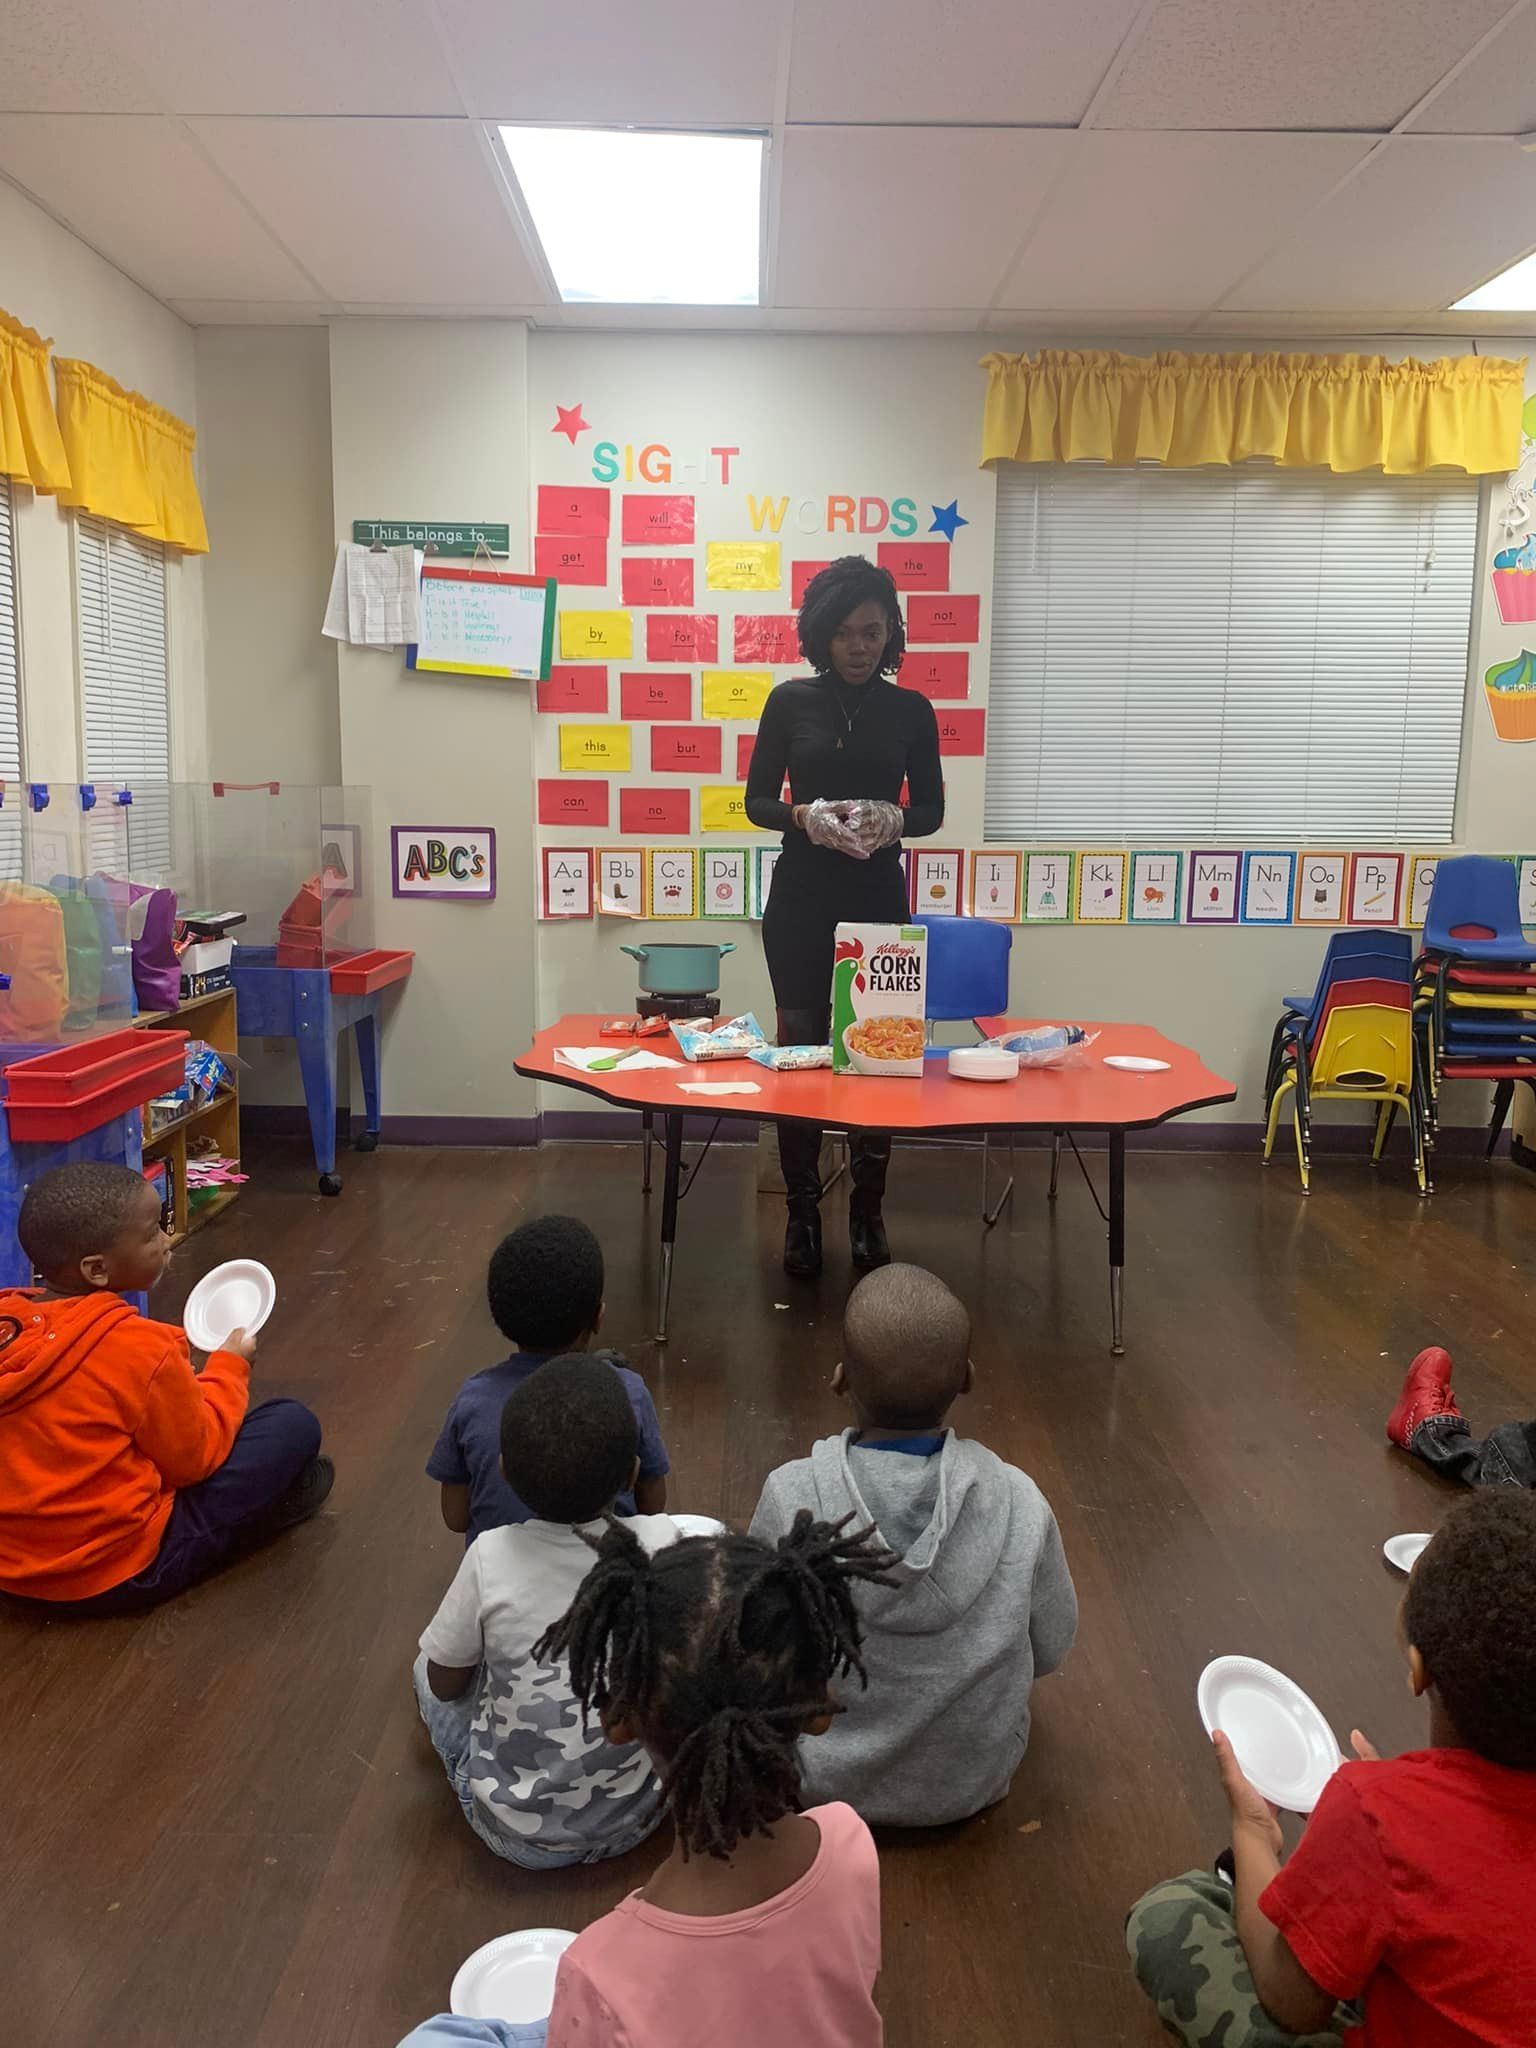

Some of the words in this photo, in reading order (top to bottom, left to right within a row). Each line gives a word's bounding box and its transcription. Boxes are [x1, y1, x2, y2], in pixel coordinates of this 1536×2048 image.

[591, 441, 740, 485] SIGHT
[570, 504, 578, 512] a
[648, 512, 669, 523] will
[747, 494, 918, 538] WORDS
[369, 524, 400, 540] This
[406, 524, 463, 543] belongs
[561, 553, 581, 565] get
[904, 560, 924, 571] the
[735, 562, 753, 573] my
[654, 576, 663, 587] is
[934, 611, 953, 621] not
[590, 627, 603, 640] by
[674, 630, 691, 642] for
[929, 667, 937, 677] it
[650, 687, 664, 698] be
[732, 688, 744, 697] or
[943, 725, 956, 735] do
[585, 739, 607, 752] this
[677, 741, 696, 753] but
[563, 798, 585, 807] can
[729, 802, 742, 812] go
[649, 807, 663, 816] no
[403, 839, 486, 882] ABC's
[554, 862, 582, 878] Aa
[610, 861, 634, 878] Bb
[661, 861, 684, 878] Cc
[713, 861, 736, 878] Dd
[927, 863, 949, 879] Hh
[1091, 865, 1113, 881] Kk
[1198, 864, 1233, 882] Mm
[1257, 865, 1281, 881] Nn
[1310, 866, 1334, 883] Oo
[1042, 864, 1055, 889] Jj
[1366, 866, 1386, 891] Pp
[869, 955, 921, 975] CORN
[870, 975, 921, 992] FLAKES
